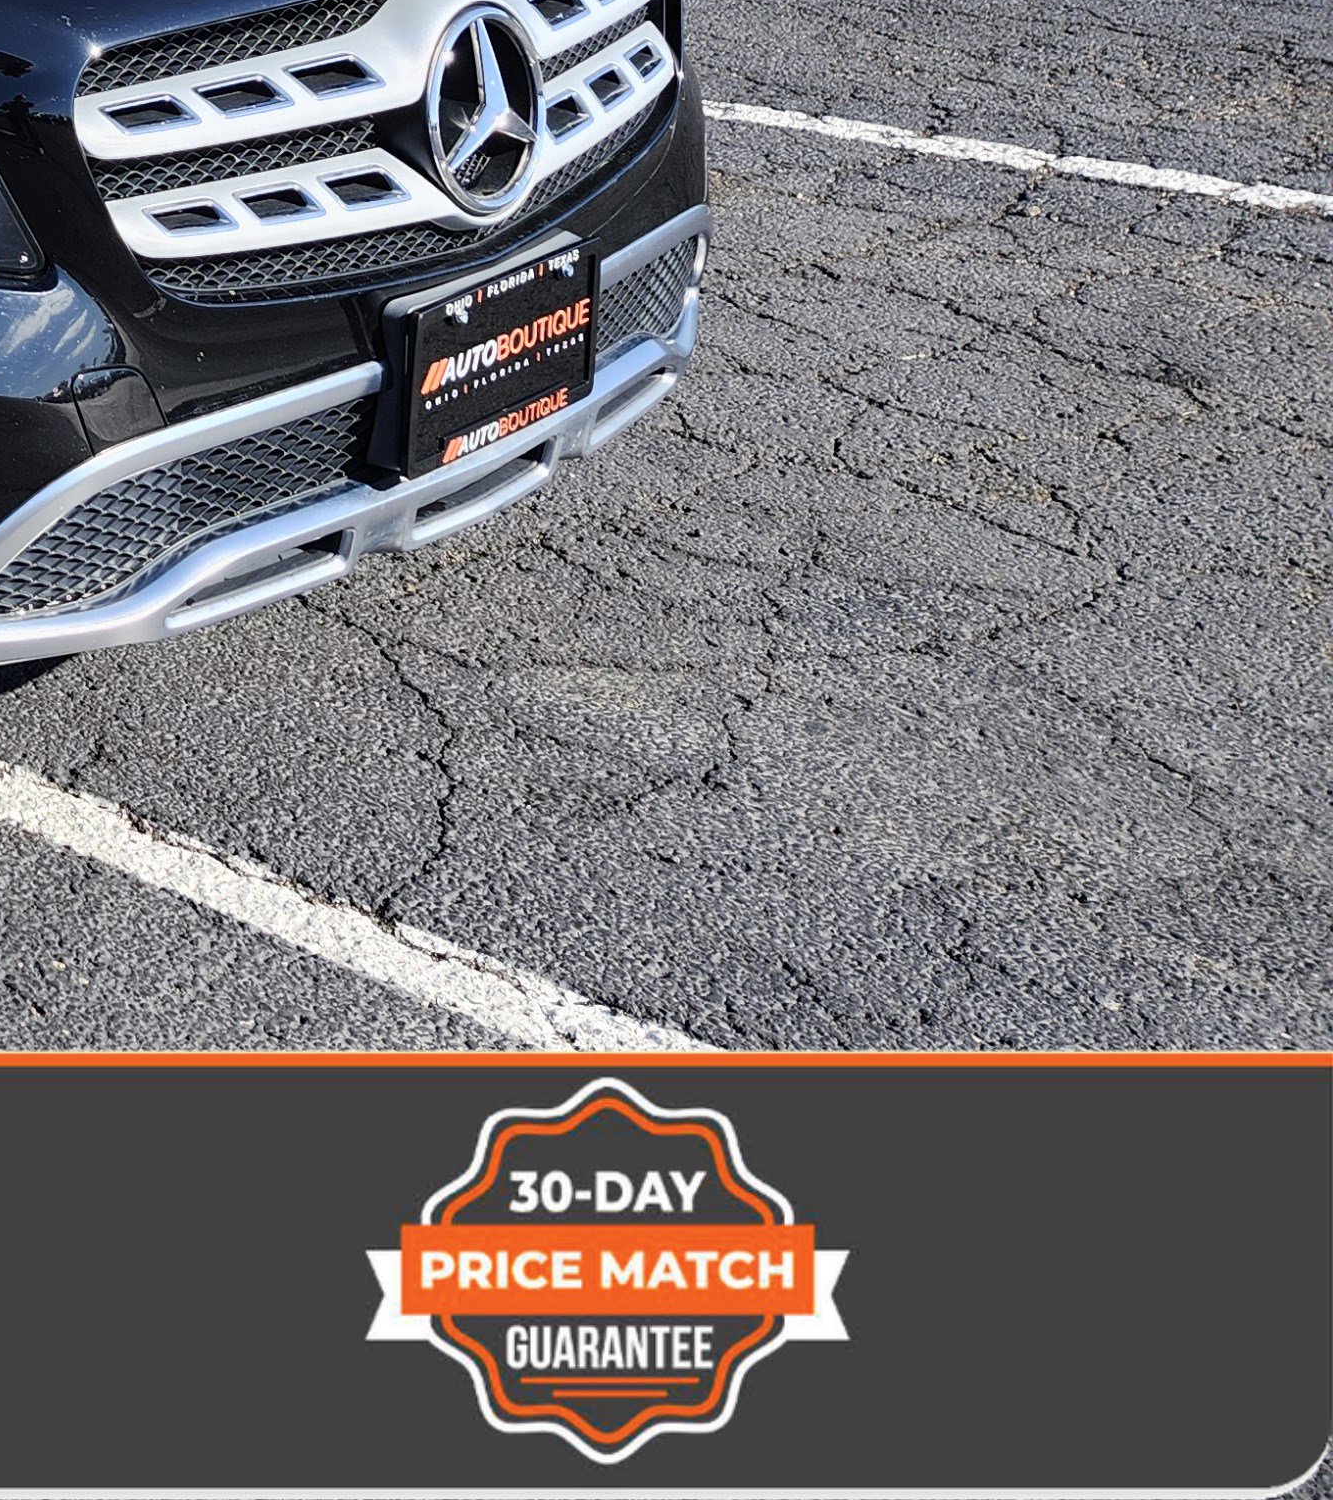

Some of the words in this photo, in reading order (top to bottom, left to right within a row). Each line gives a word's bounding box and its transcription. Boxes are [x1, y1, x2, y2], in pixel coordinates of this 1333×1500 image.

[445, 294, 472, 316] OHIO
[487, 269, 534, 297] FLORIDA
[548, 249, 580, 271] TEXAS
[441, 298, 590, 386] AUTOBOUTIQUE
[457, 387, 568, 457] AUTOBOUTIQUE
